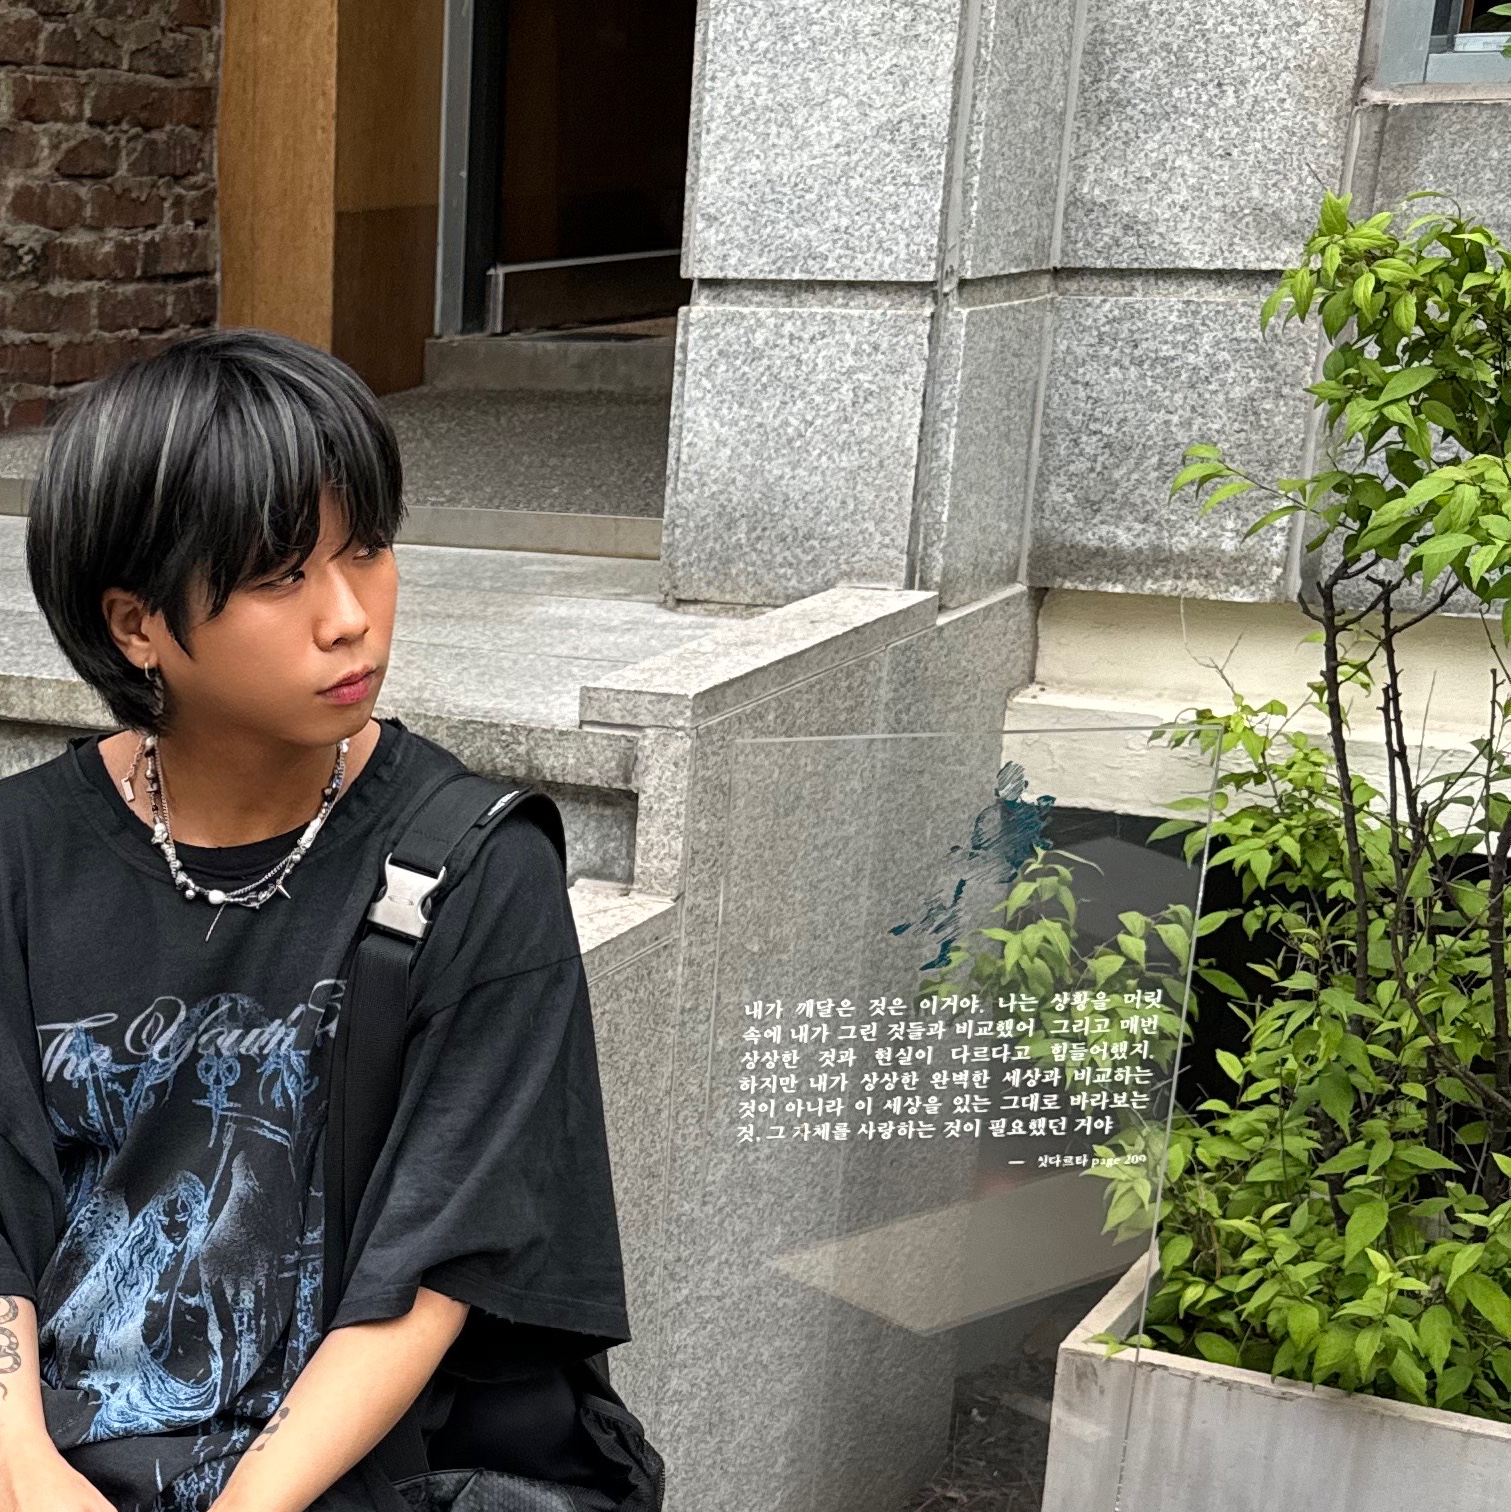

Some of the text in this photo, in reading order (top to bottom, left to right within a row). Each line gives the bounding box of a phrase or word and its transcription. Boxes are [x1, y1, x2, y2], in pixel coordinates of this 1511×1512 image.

[744, 989, 1162, 1020] 내가 깨달은 것은 이거야. 나는 상황을 머릿
[742, 1015, 1159, 1045] 속에 내가 그린 것들과 비교했어 그리고 매번
[740, 1040, 1153, 1070] 상상한 것과 현실이 다르다고 힘들어했지.
[739, 1066, 1153, 1094] 하지만 내가 상상한 완벽한 세상과 비교하는
[739, 1091, 1150, 1119] 것이 아니라 이 세상을 있는 그대로 바라보는
[766, 1126, 786, 1140] 그
[792, 1122, 851, 1141] 자체를
[857, 1120, 936, 1140] 사랑하는
[943, 1118, 981, 1139] 것이
[988, 1117, 1067, 1137] 필요했던
[1074, 1116, 1114, 1135] 거야
[1091, 1157, 1121, 1168] page
